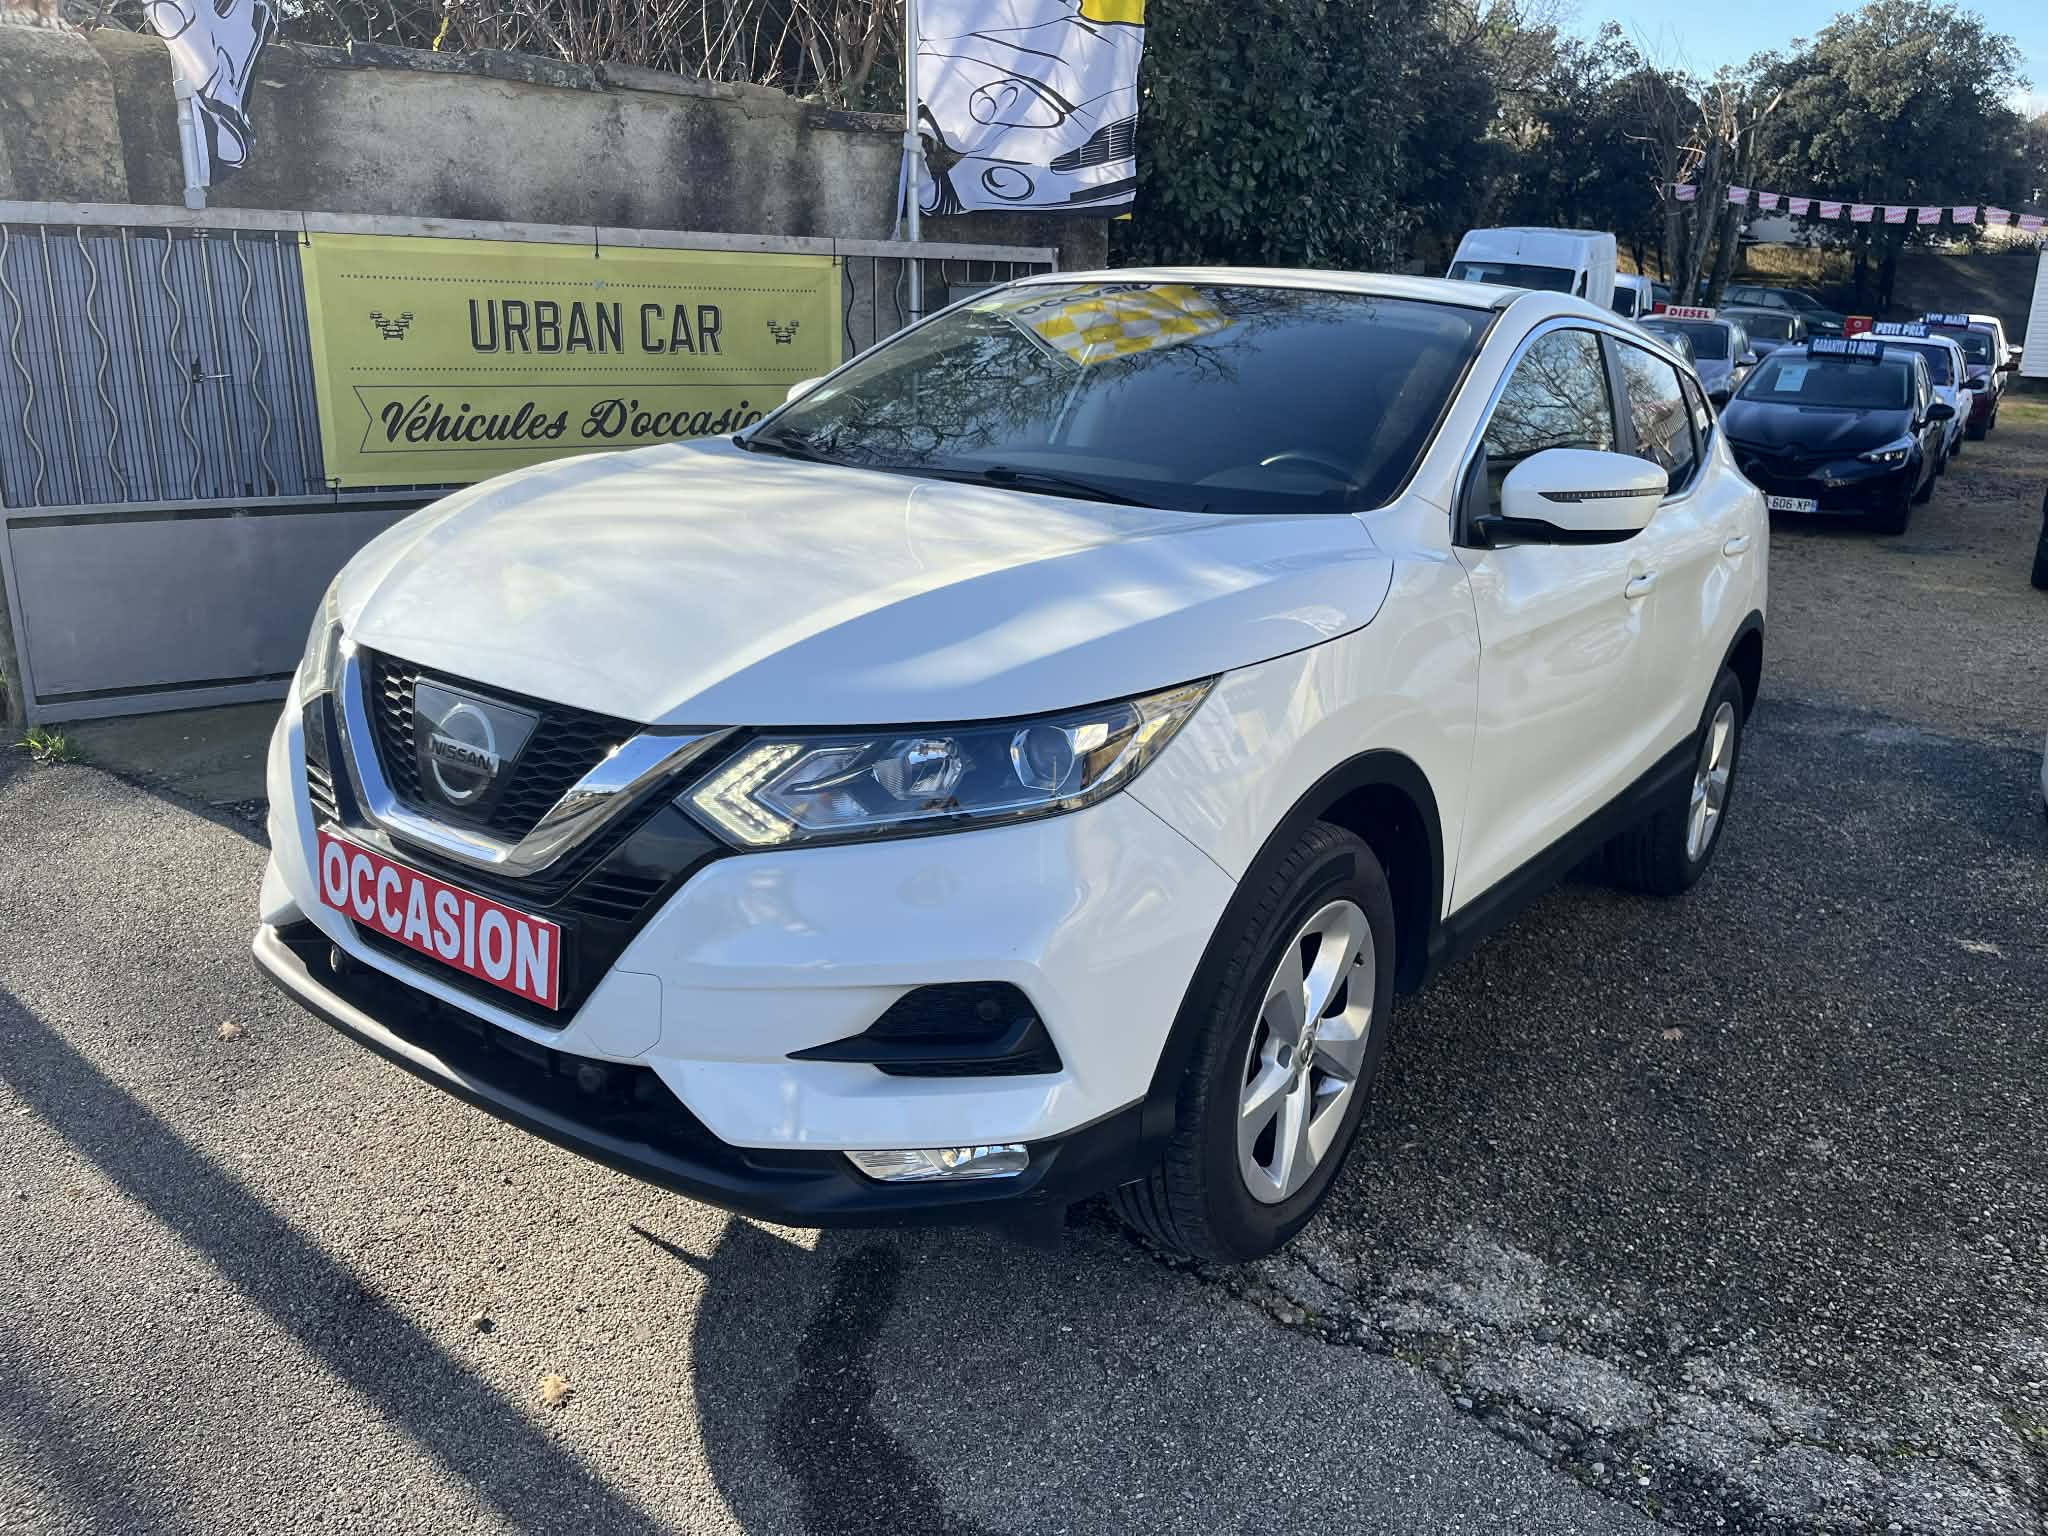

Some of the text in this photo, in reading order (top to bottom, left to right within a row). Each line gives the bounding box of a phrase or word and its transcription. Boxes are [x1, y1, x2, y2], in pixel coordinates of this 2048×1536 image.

[468, 298, 723, 355] URBAN CAR
[1669, 307, 1710, 319] DIESEL
[1875, 322, 1927, 337] PETIT PRIX
[381, 394, 764, 443] Véhicules D'occasio
[430, 736, 491, 770] NISSAN
[323, 841, 550, 1000] OCCASION
